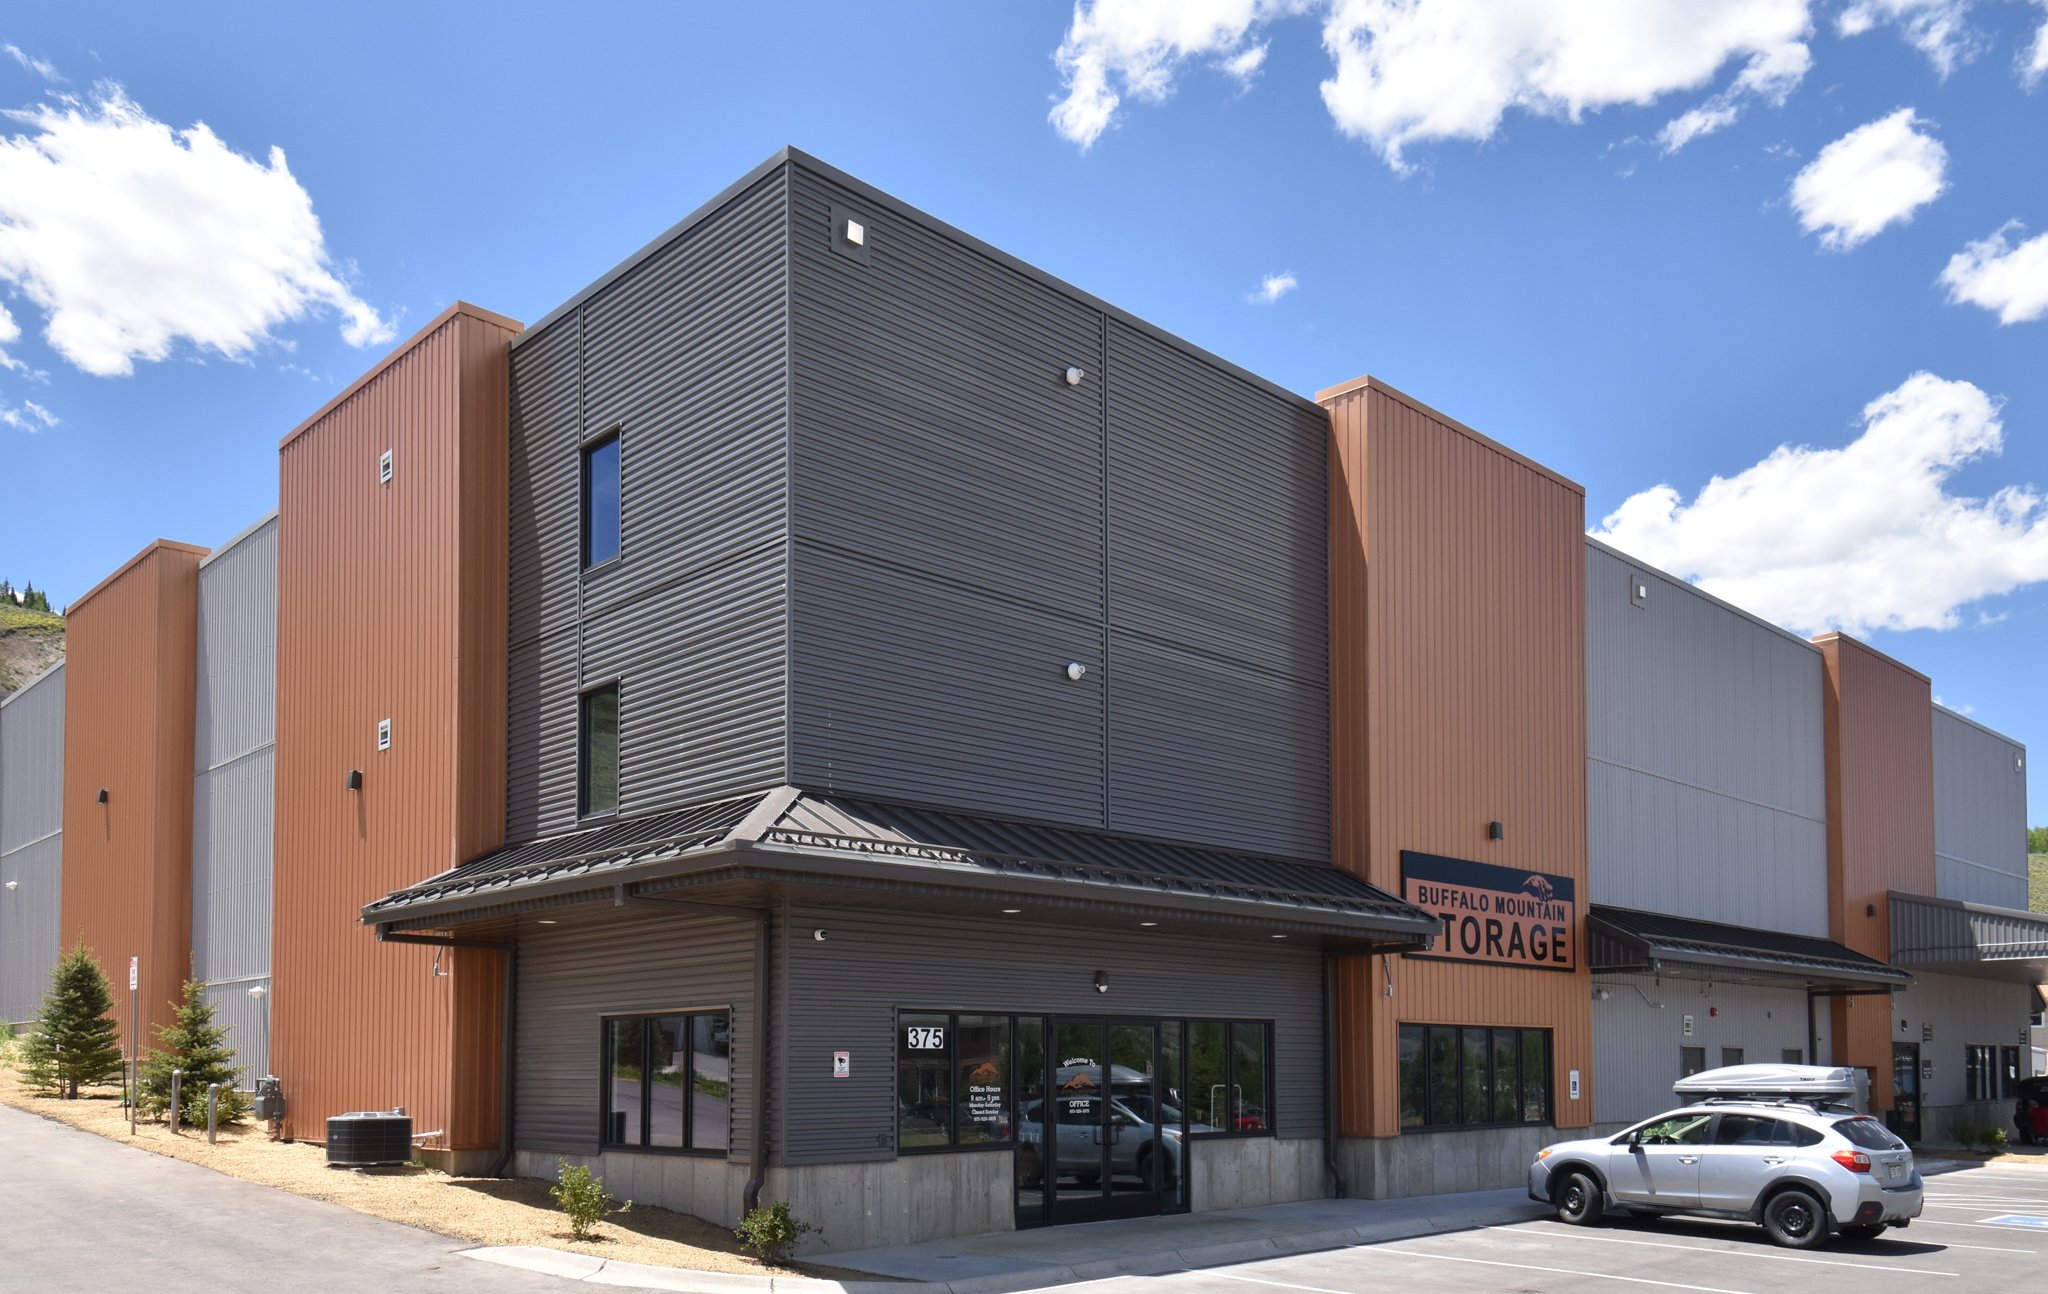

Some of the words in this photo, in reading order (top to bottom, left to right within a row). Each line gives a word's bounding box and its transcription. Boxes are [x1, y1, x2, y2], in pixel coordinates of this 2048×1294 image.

[1418, 885, 1489, 912] BUFFALO
[1495, 896, 1565, 922] MOUNTAIN
[1434, 912, 1567, 963] TORAGE
[909, 1028, 943, 1048] 375
[1063, 1057, 1088, 1067] Welcome
[1089, 1058, 1096, 1068] To
